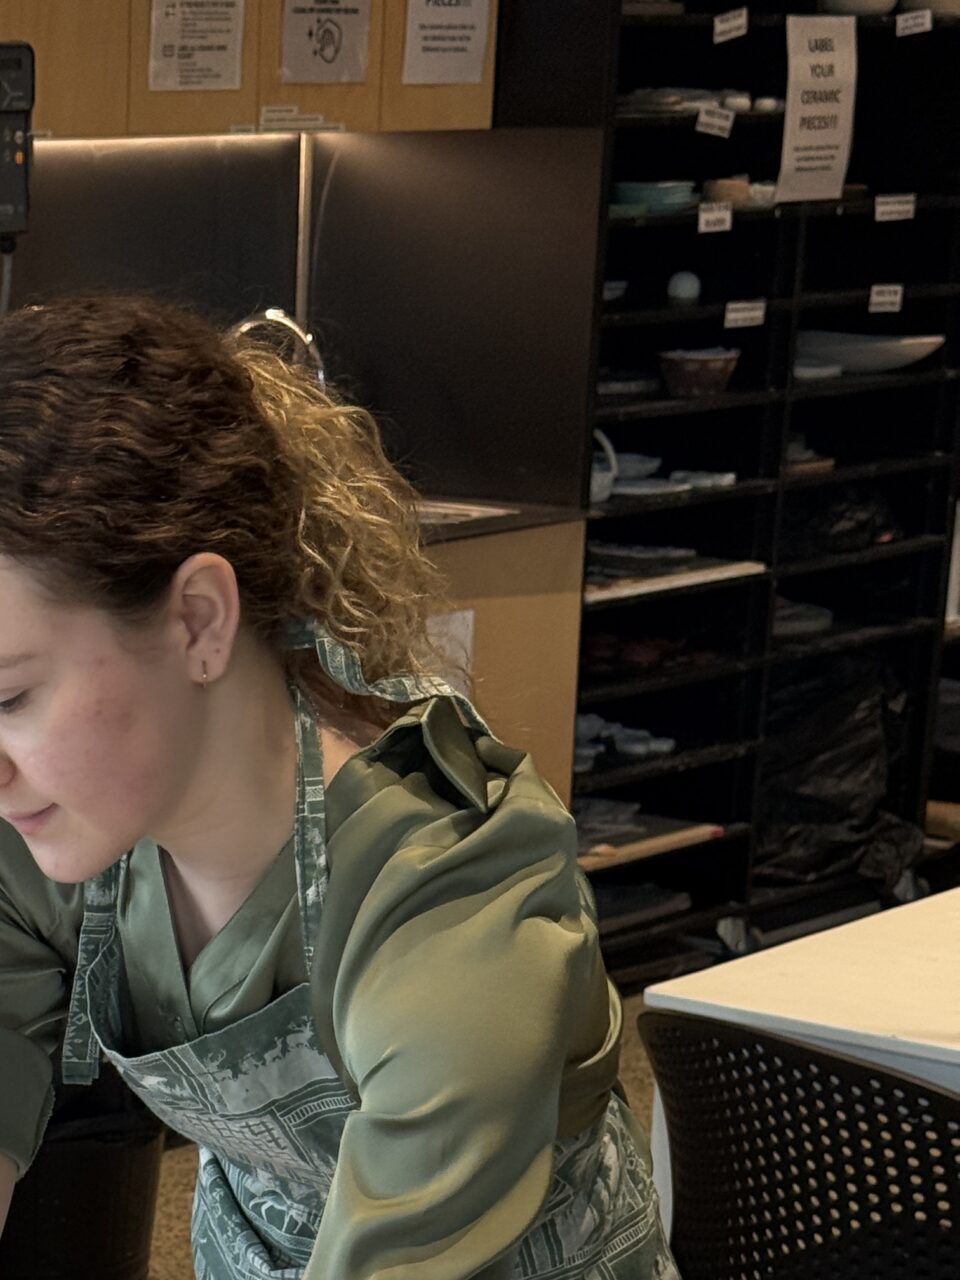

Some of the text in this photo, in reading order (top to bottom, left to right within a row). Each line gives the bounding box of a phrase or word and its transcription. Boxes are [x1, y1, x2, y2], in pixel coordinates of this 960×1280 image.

[808, 38, 834, 52] LABEL
[810, 63, 835, 78] YOUR
[800, 89, 841, 105] CERAMIC
